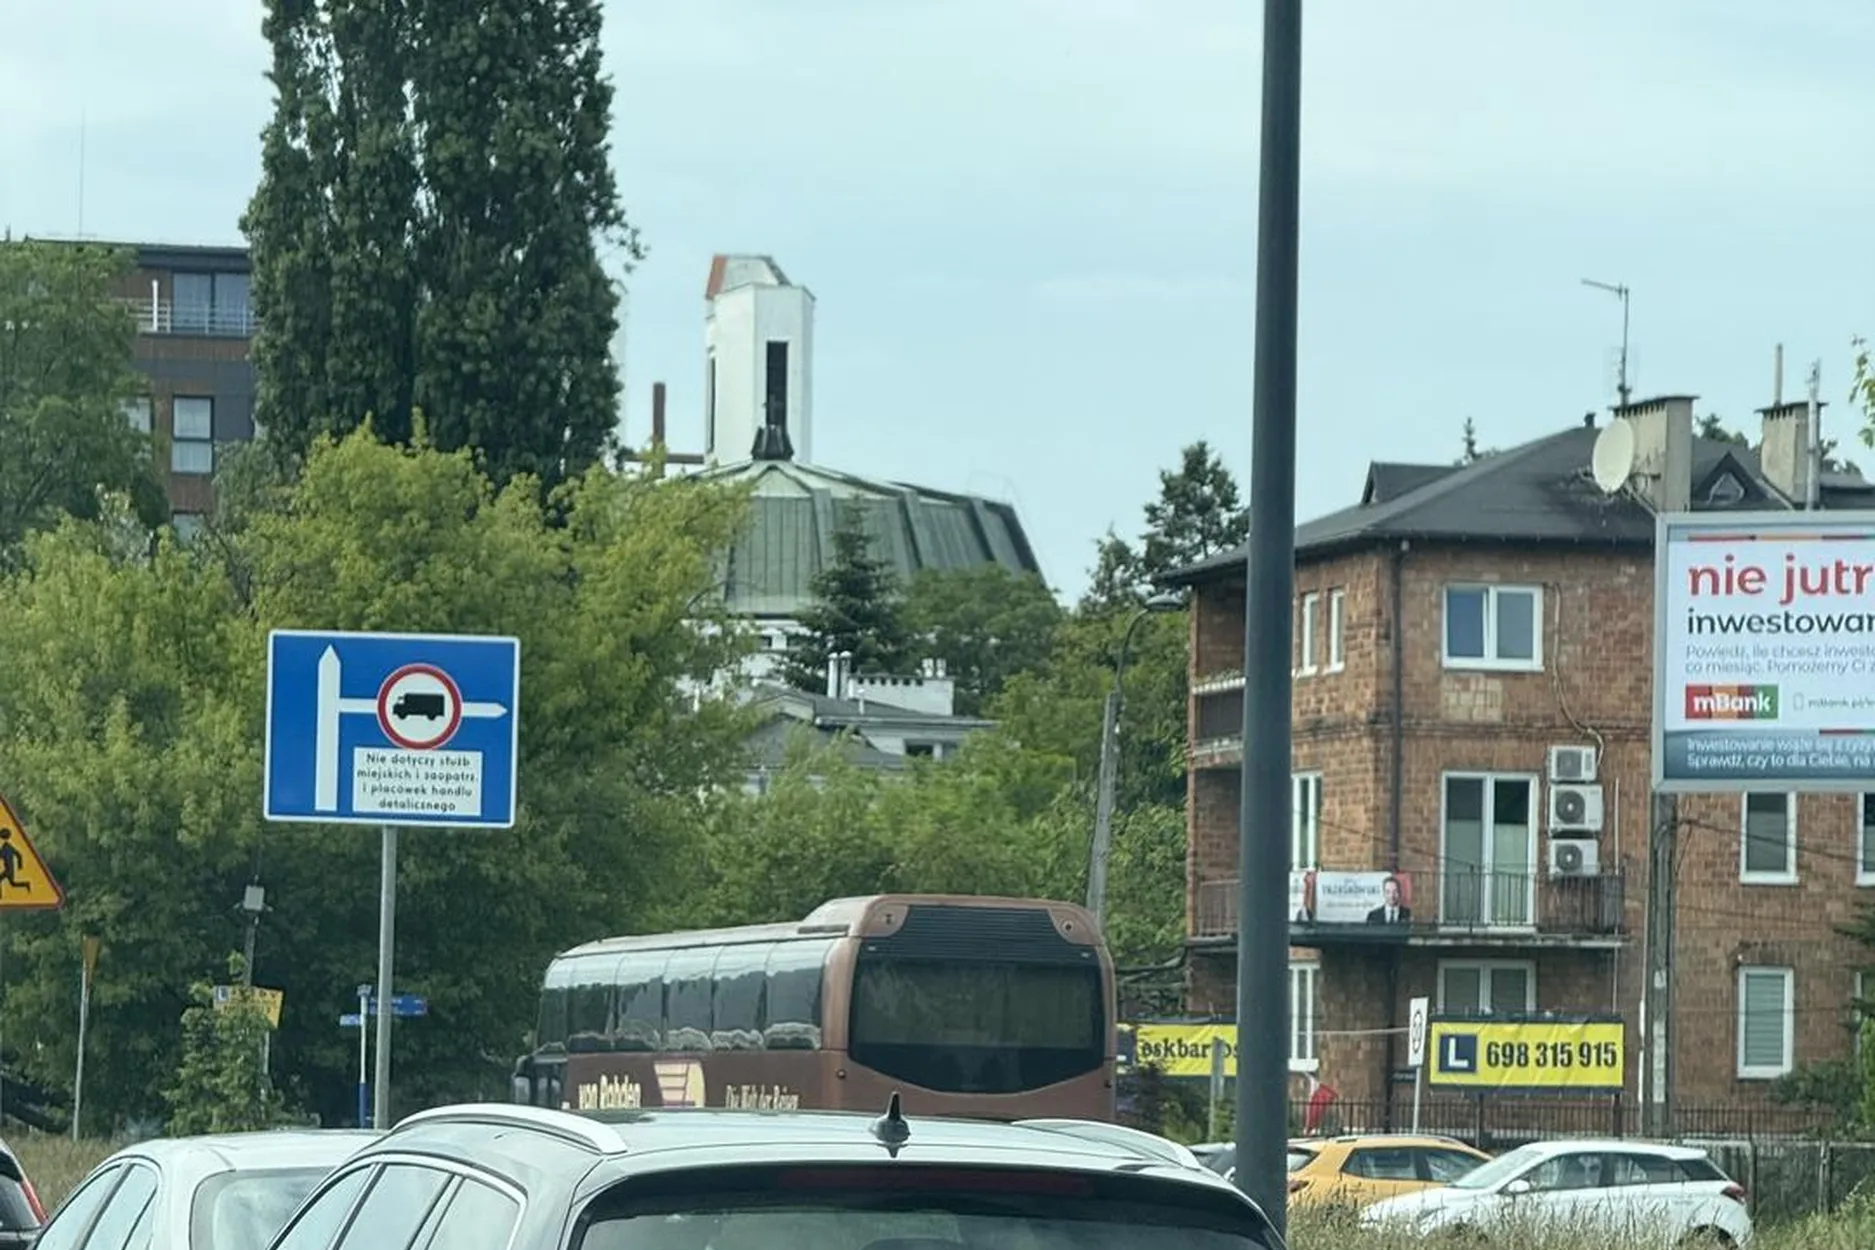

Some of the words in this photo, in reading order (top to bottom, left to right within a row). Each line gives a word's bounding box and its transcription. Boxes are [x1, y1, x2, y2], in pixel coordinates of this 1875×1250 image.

[1688, 553, 1767, 596] nie
[1779, 553, 1874, 605] jutr
[1693, 692, 1771, 712] mBank
[366, 753, 387, 764] Nie
[391, 754, 435, 767] dotyczy
[357, 768, 412, 780] miejskich
[432, 785, 473, 797] handlu
[379, 799, 456, 812] detalicznego
[1448, 1037, 1469, 1068] L
[1486, 1041, 1529, 1068] 698
[1535, 1041, 1573, 1068] 315
[1579, 1041, 1617, 1068] 915
